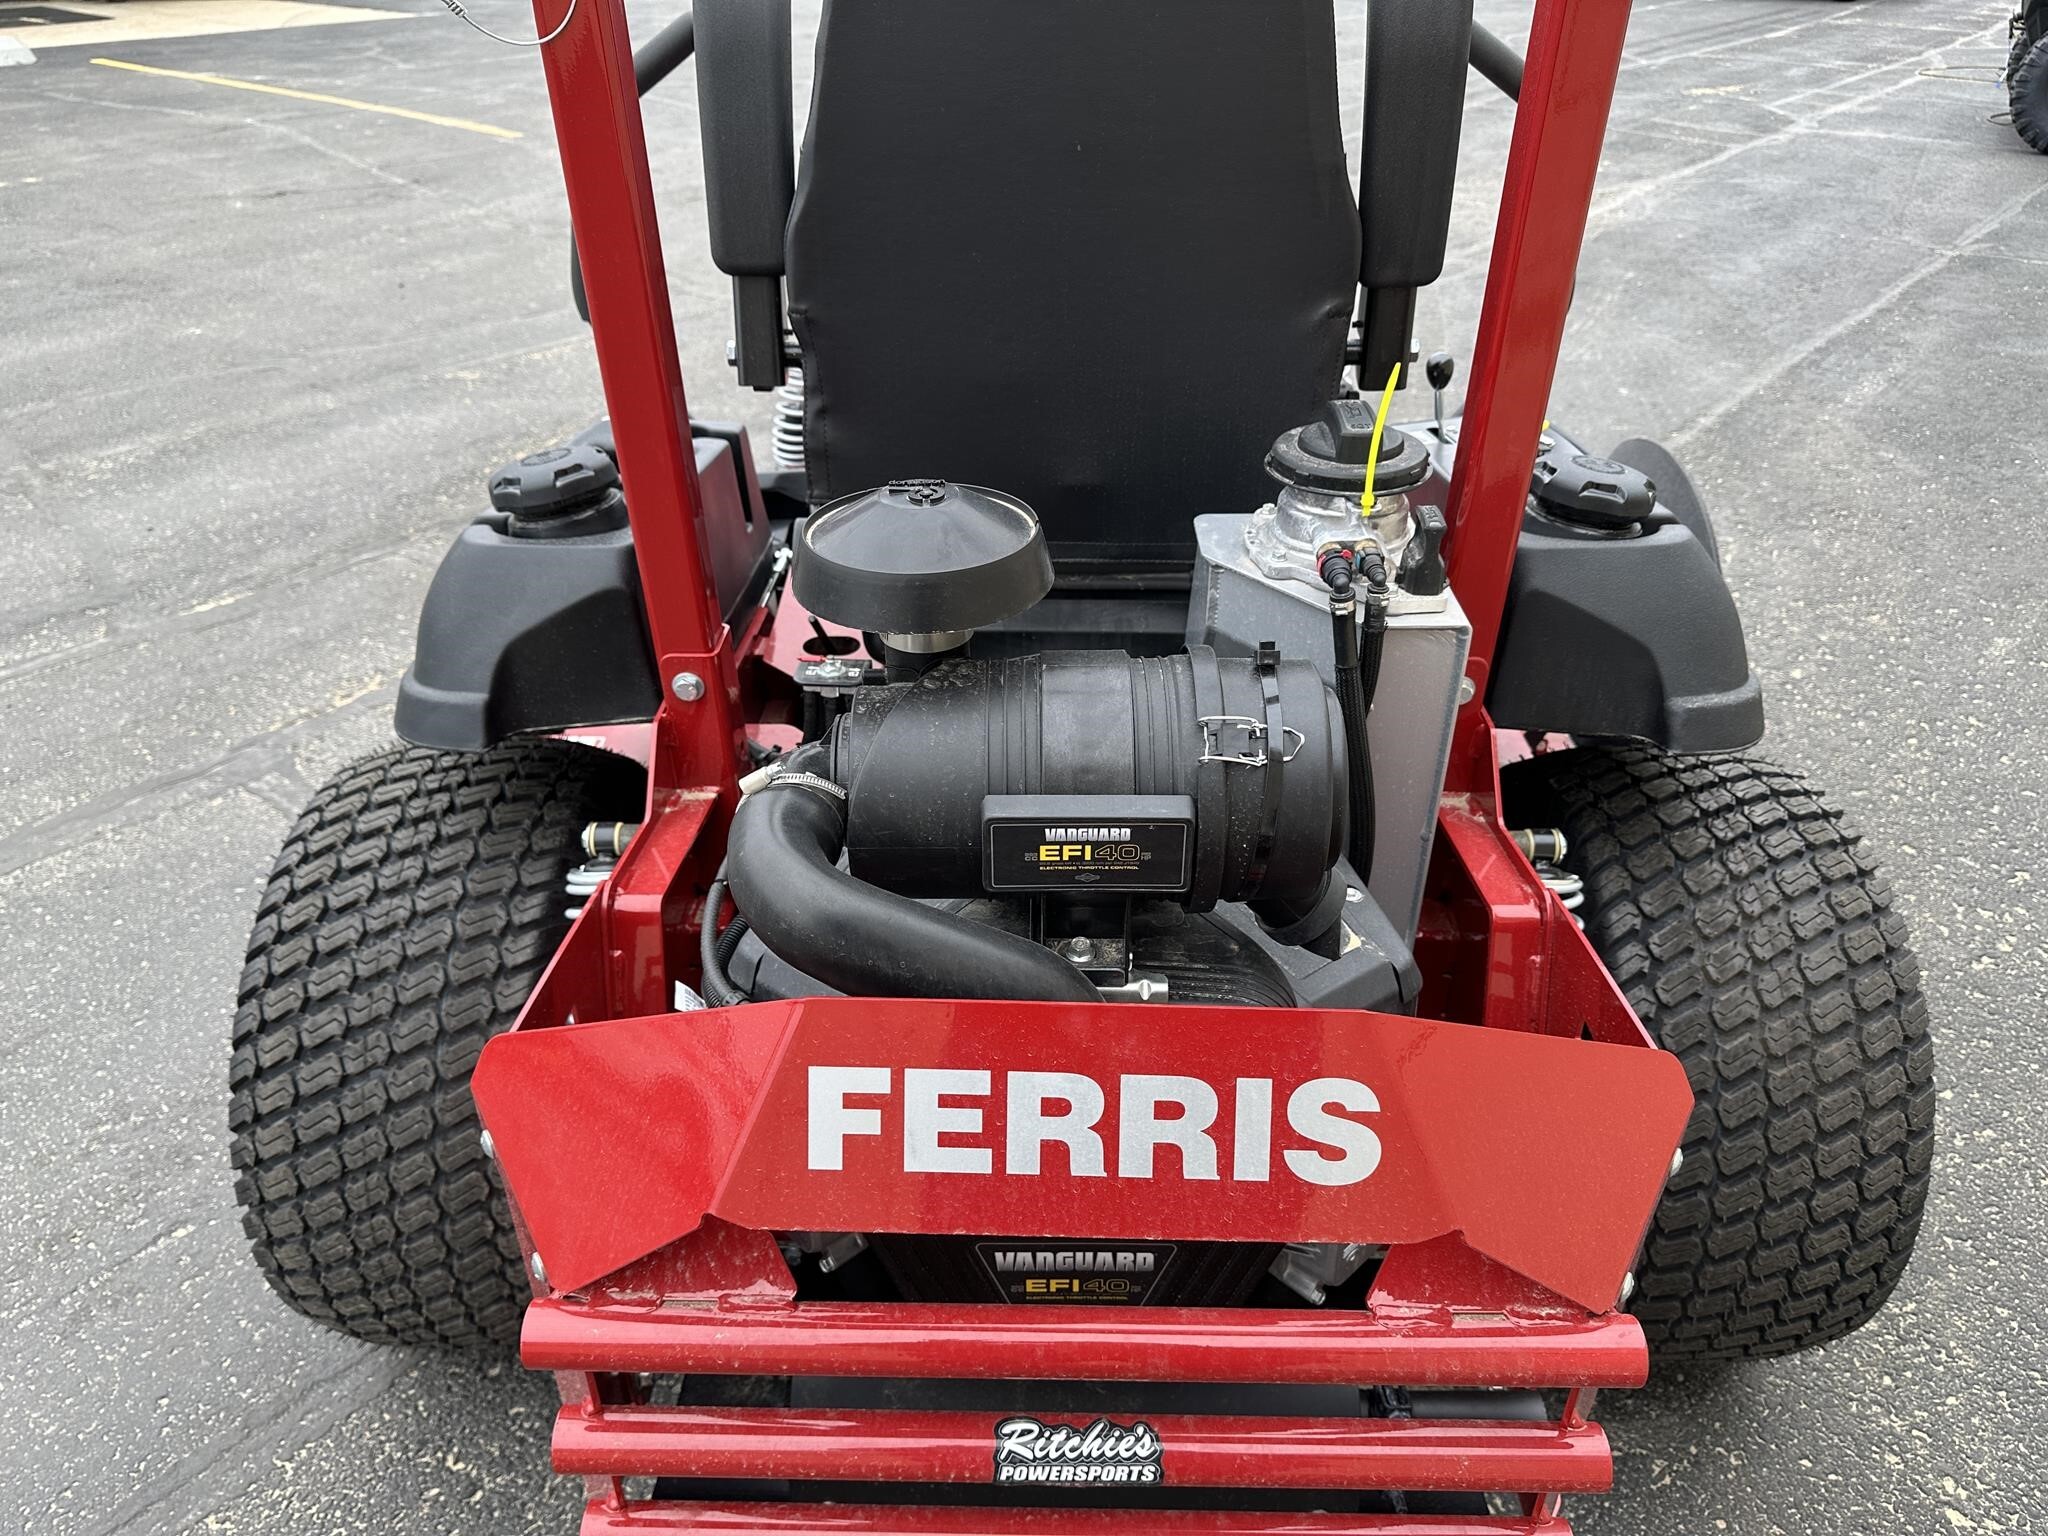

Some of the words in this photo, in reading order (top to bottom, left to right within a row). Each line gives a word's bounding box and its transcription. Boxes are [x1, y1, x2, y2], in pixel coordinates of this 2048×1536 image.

[1044, 828, 1132, 842] VANGUARD
[1039, 845, 1092, 861] EFI
[1094, 844, 1141, 861] 40
[807, 1065, 1382, 1186] FERRIS
[994, 1251, 1155, 1272] VANGUARD
[1025, 1279, 1080, 1293] EFI
[1082, 1278, 1130, 1293] 40
[1000, 1421, 1155, 1461] Ritchie's
[999, 1465, 1156, 1482] POWERSPORTS
